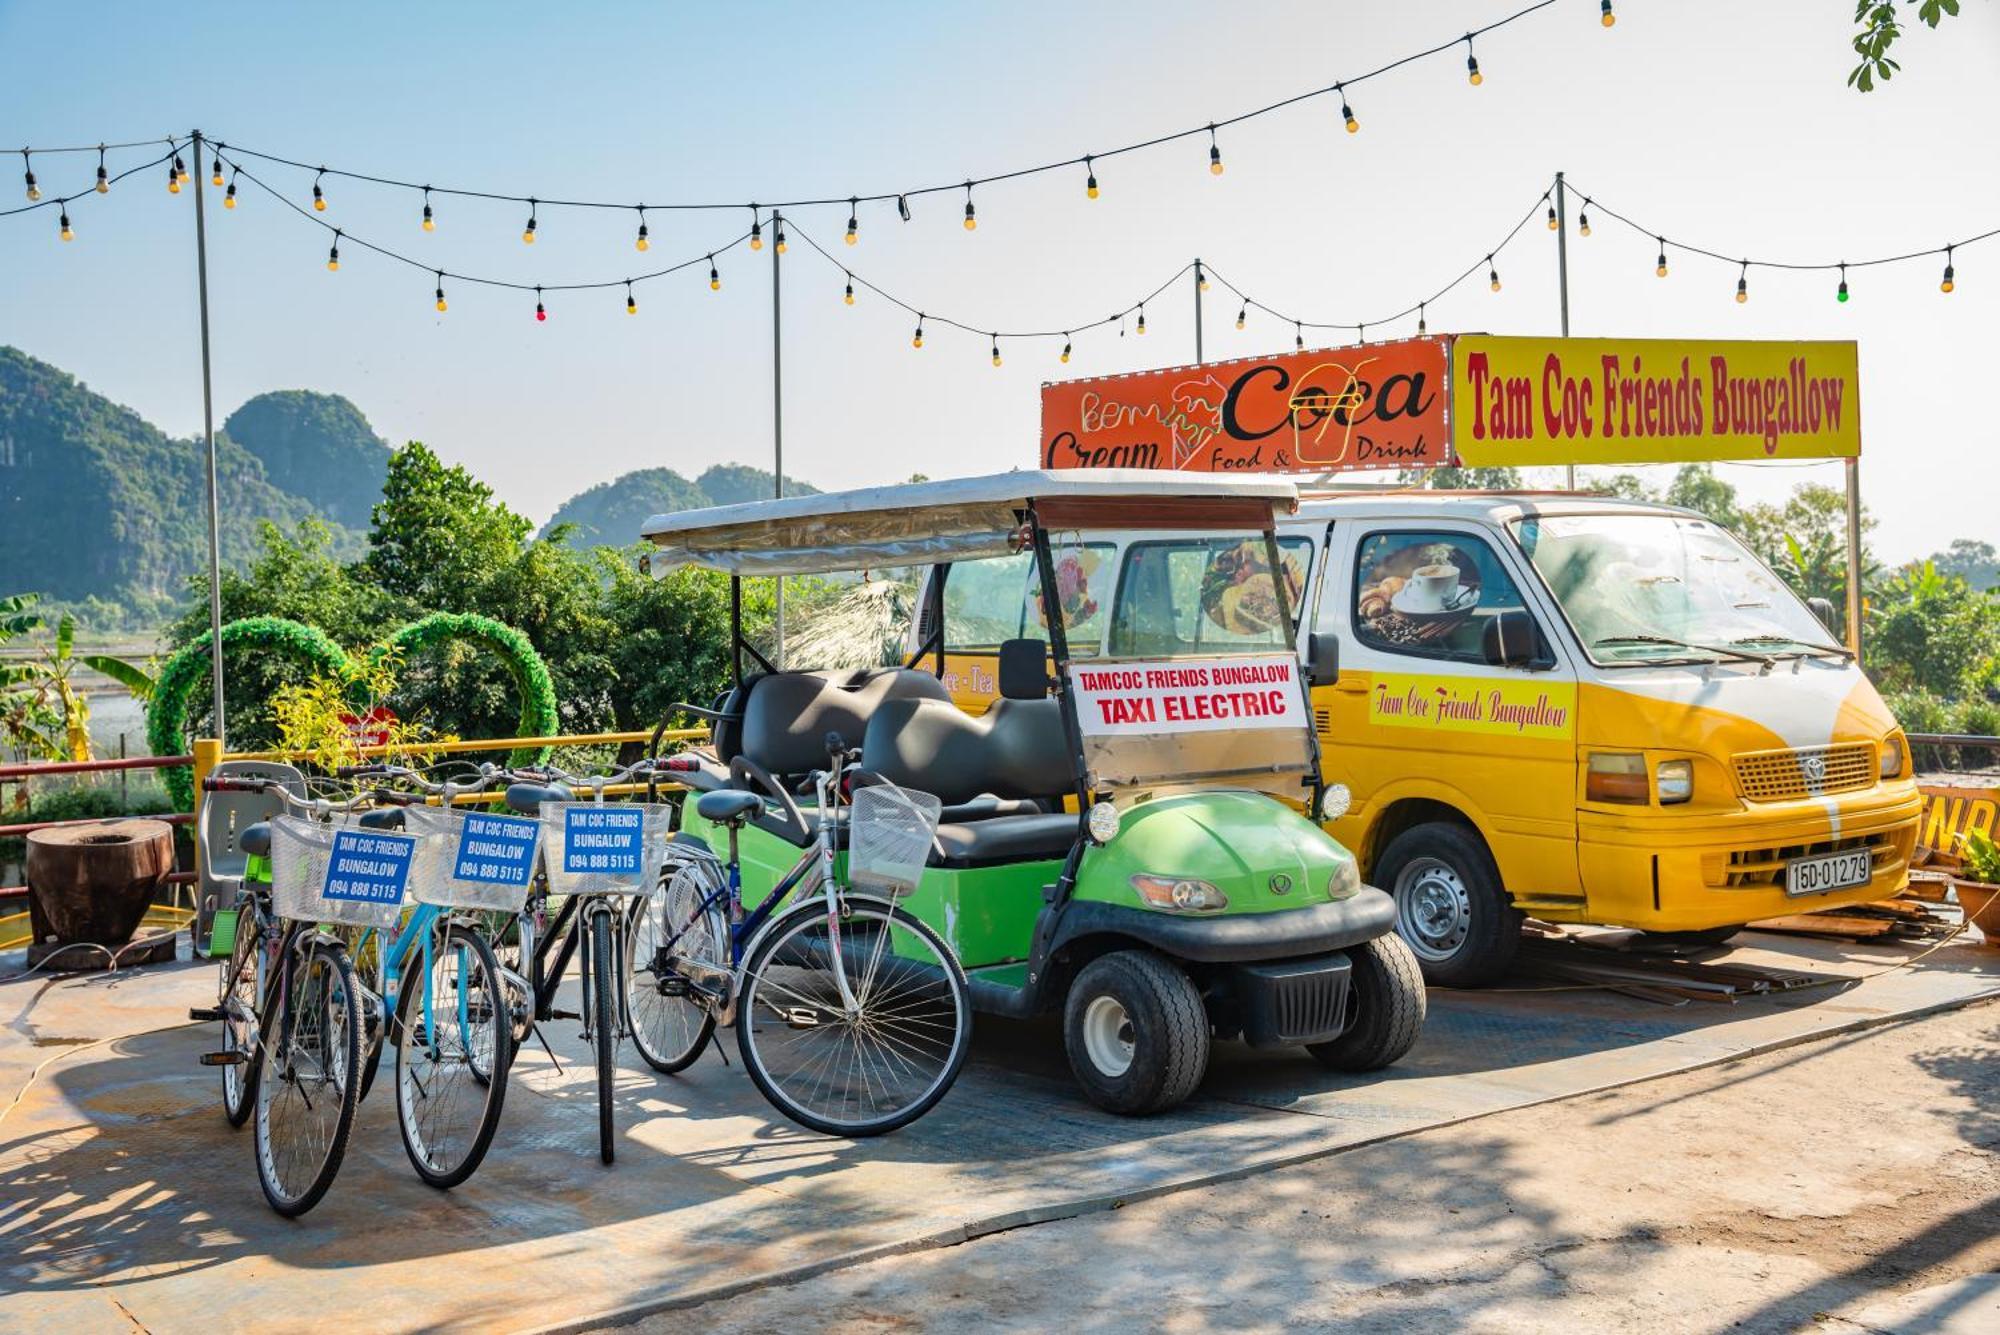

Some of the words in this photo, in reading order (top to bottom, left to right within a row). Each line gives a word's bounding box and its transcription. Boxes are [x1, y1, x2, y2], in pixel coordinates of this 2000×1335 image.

[1222, 365, 1436, 441] Coca
[1467, 351, 1533, 440] Tam
[1542, 352, 1593, 439] Coc
[1601, 354, 1702, 438] Friends
[1710, 355, 1844, 455] Bungallow
[1211, 445, 1262, 471] Food
[1272, 449, 1291, 466] &
[1356, 434, 1427, 460] Drink
[971, 664, 994, 693] Tea
[1079, 671, 1142, 692] TAMCOC
[1146, 668, 1209, 689] FRIENDS
[1212, 664, 1290, 686] BUNGALOW
[1097, 697, 1156, 725] TAXI
[1163, 690, 1287, 722] ELECTRIC
[1375, 683, 1402, 716] Tam
[1435, 686, 1483, 724] Friends
[1488, 689, 1567, 731] Bungallow
[467, 819, 485, 835] TAM
[485, 821, 502, 836] COC
[502, 822, 536, 840] FRIENDS
[570, 813, 587, 828] TAM
[587, 814, 604, 828] COC
[605, 814, 638, 828] FRIENDS
[339, 836, 355, 852] TAM
[357, 838, 374, 853] COC
[374, 839, 409, 857] FRIENDS
[467, 840, 525, 859] BUNGALOW
[573, 834, 632, 848] BUNGALOW
[337, 858, 398, 877] BUNGALOW
[459, 861, 479, 876] 094
[480, 864, 499, 878] 888
[499, 866, 524, 881] 5115
[569, 855, 588, 868] 094
[590, 855, 609, 868] 888
[610, 855, 635, 868] 5115
[328, 879, 349, 895] 094
[350, 881, 370, 897] 888
[370, 884, 397, 899] 5115
